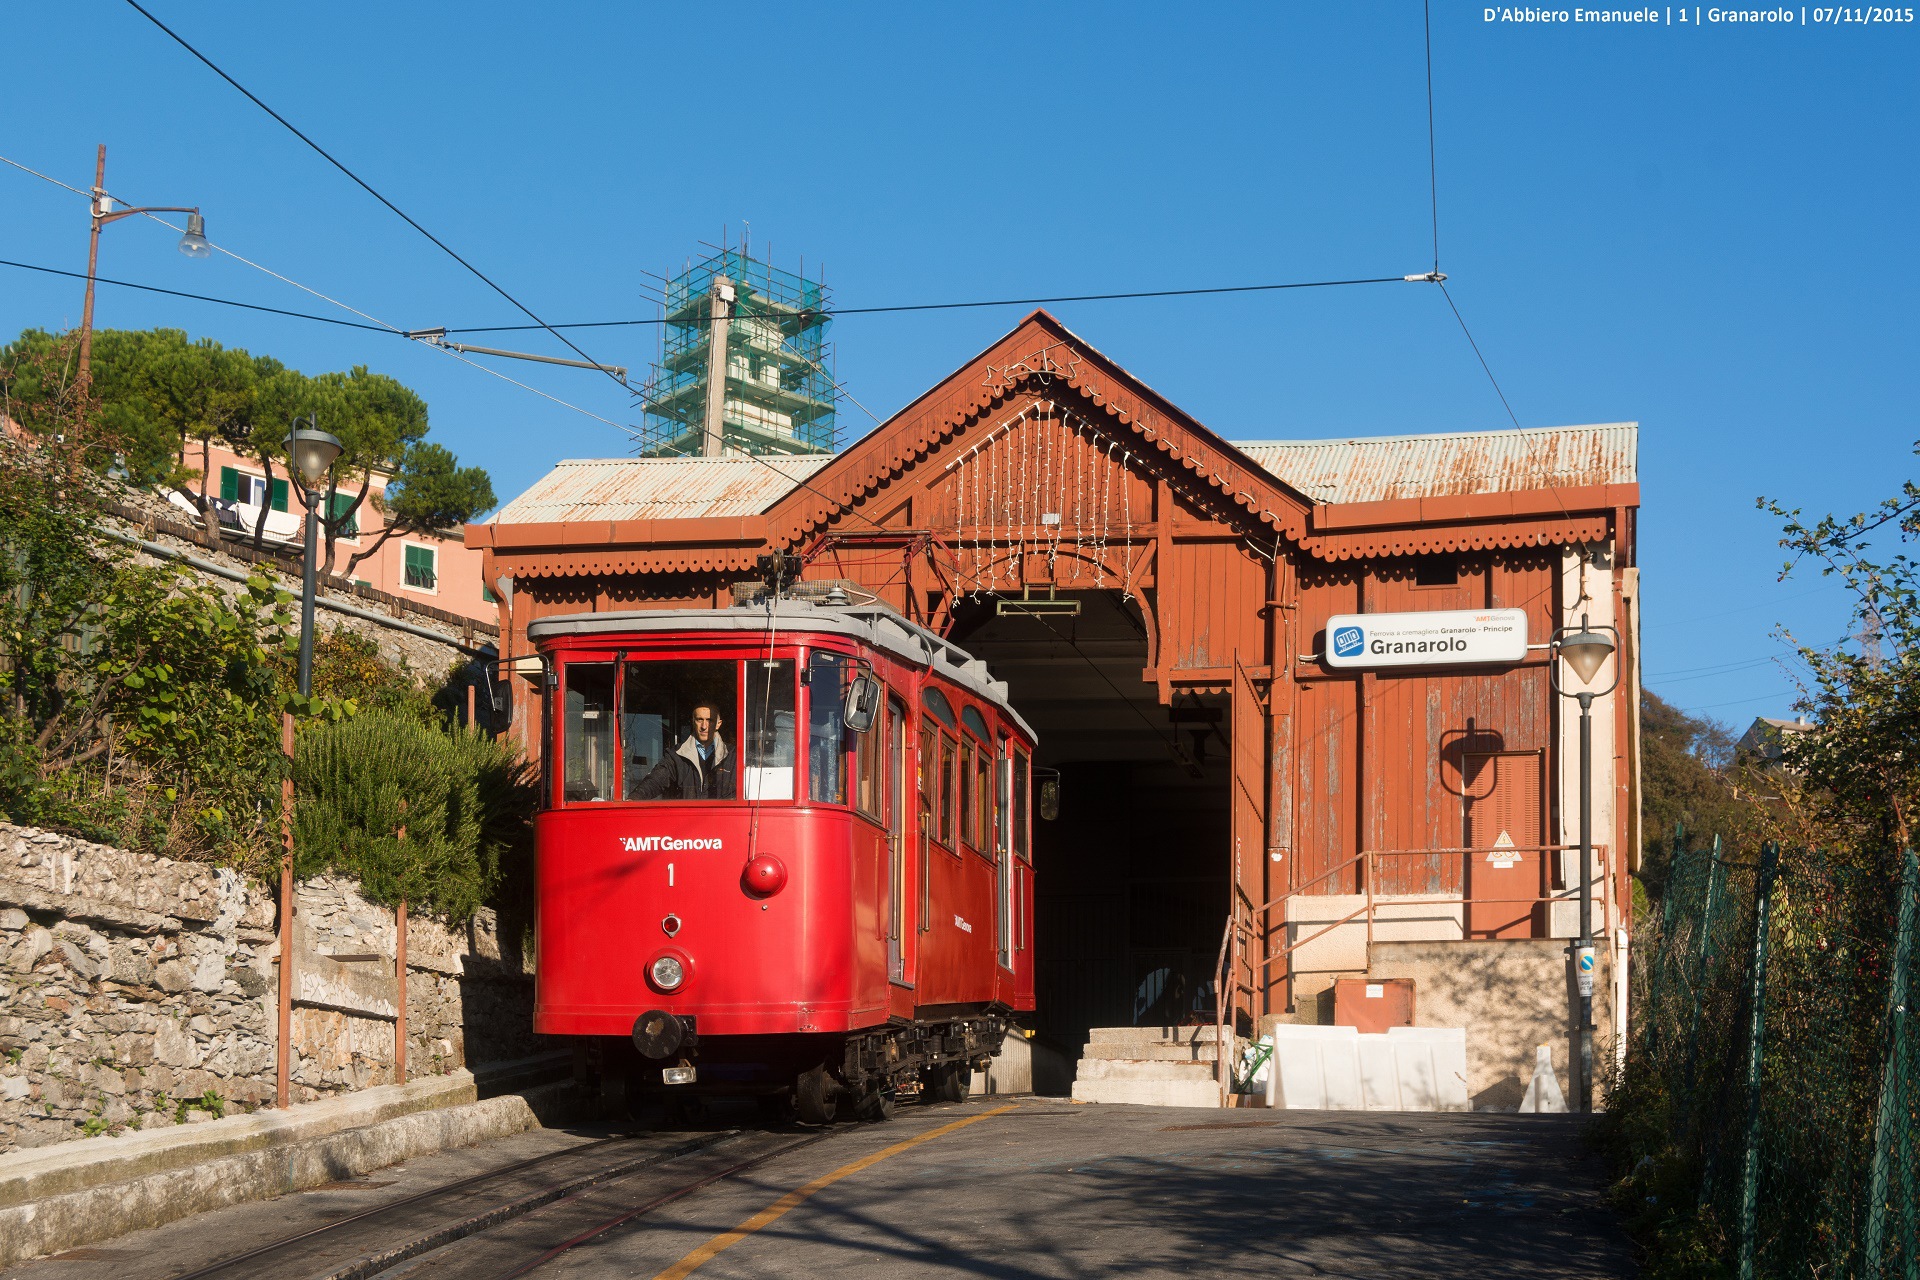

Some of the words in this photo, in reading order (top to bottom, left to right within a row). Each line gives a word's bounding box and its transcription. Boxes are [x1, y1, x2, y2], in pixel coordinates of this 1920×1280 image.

[1369, 629, 1395, 637] Ferrovia
[1402, 628, 1439, 637] cremagliera
[1483, 625, 1513, 633] Principe
[1370, 636, 1467, 655] Granarolo
[623, 836, 723, 852] AMTGenova
[667, 863, 674, 887] 1
